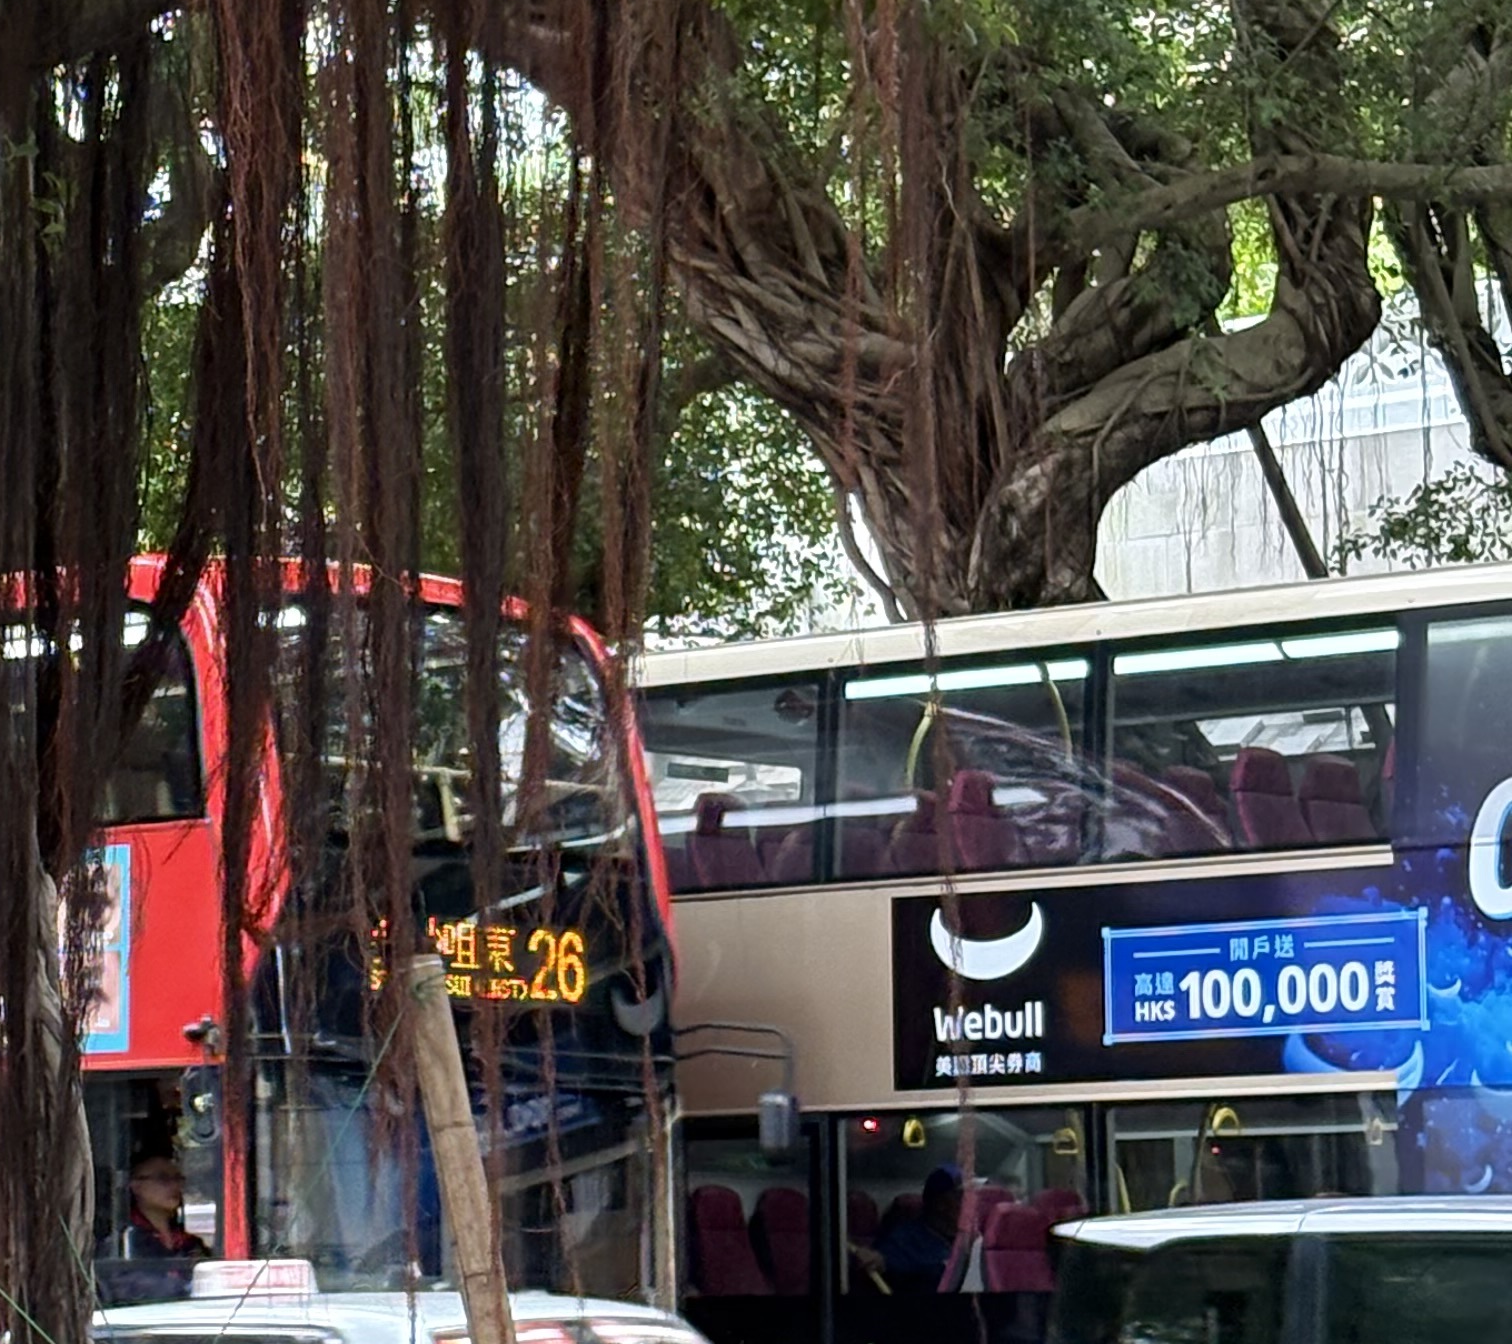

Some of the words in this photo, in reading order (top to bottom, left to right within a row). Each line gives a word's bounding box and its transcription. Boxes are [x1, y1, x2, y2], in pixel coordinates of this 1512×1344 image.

[528, 929, 586, 1004] 26
[1230, 934, 1295, 962] 開戶送
[1134, 972, 1175, 997] 高達
[1134, 1000, 1176, 1023] HK$
[1179, 961, 1370, 1024] 100,000
[1374, 960, 1396, 1012] 獎賞
[933, 1000, 1043, 1043] Webull
